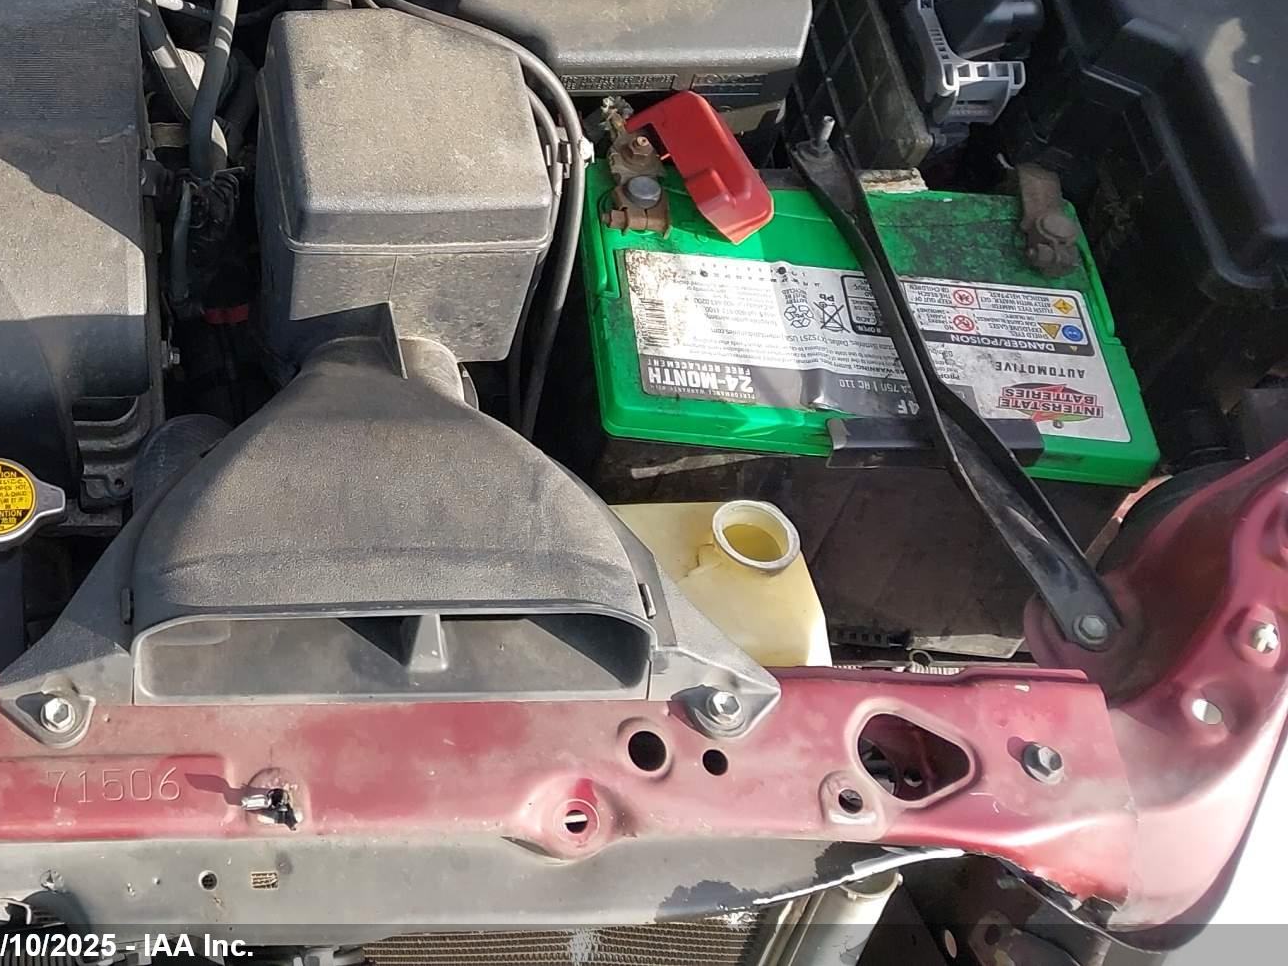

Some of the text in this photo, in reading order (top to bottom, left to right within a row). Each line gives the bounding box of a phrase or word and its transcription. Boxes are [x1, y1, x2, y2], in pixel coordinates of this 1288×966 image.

[819, 294, 834, 302] Pb
[950, 334, 1056, 351] DANGER/POISON
[648, 359, 751, 375] FREE REPLACEMENT
[995, 361, 1085, 379] AUTOMOTIVE
[648, 367, 753, 393] 24-MONTH
[839, 379, 856, 389] 110
[857, 380, 870, 390] RC
[708, 389, 756, 399] PERFORMANCE
[1005, 388, 1094, 404] BATTERIES
[897, 399, 920, 415] 4F
[1001, 398, 1101, 416] INTERSTATE
[47, 767, 181, 803] 71506
